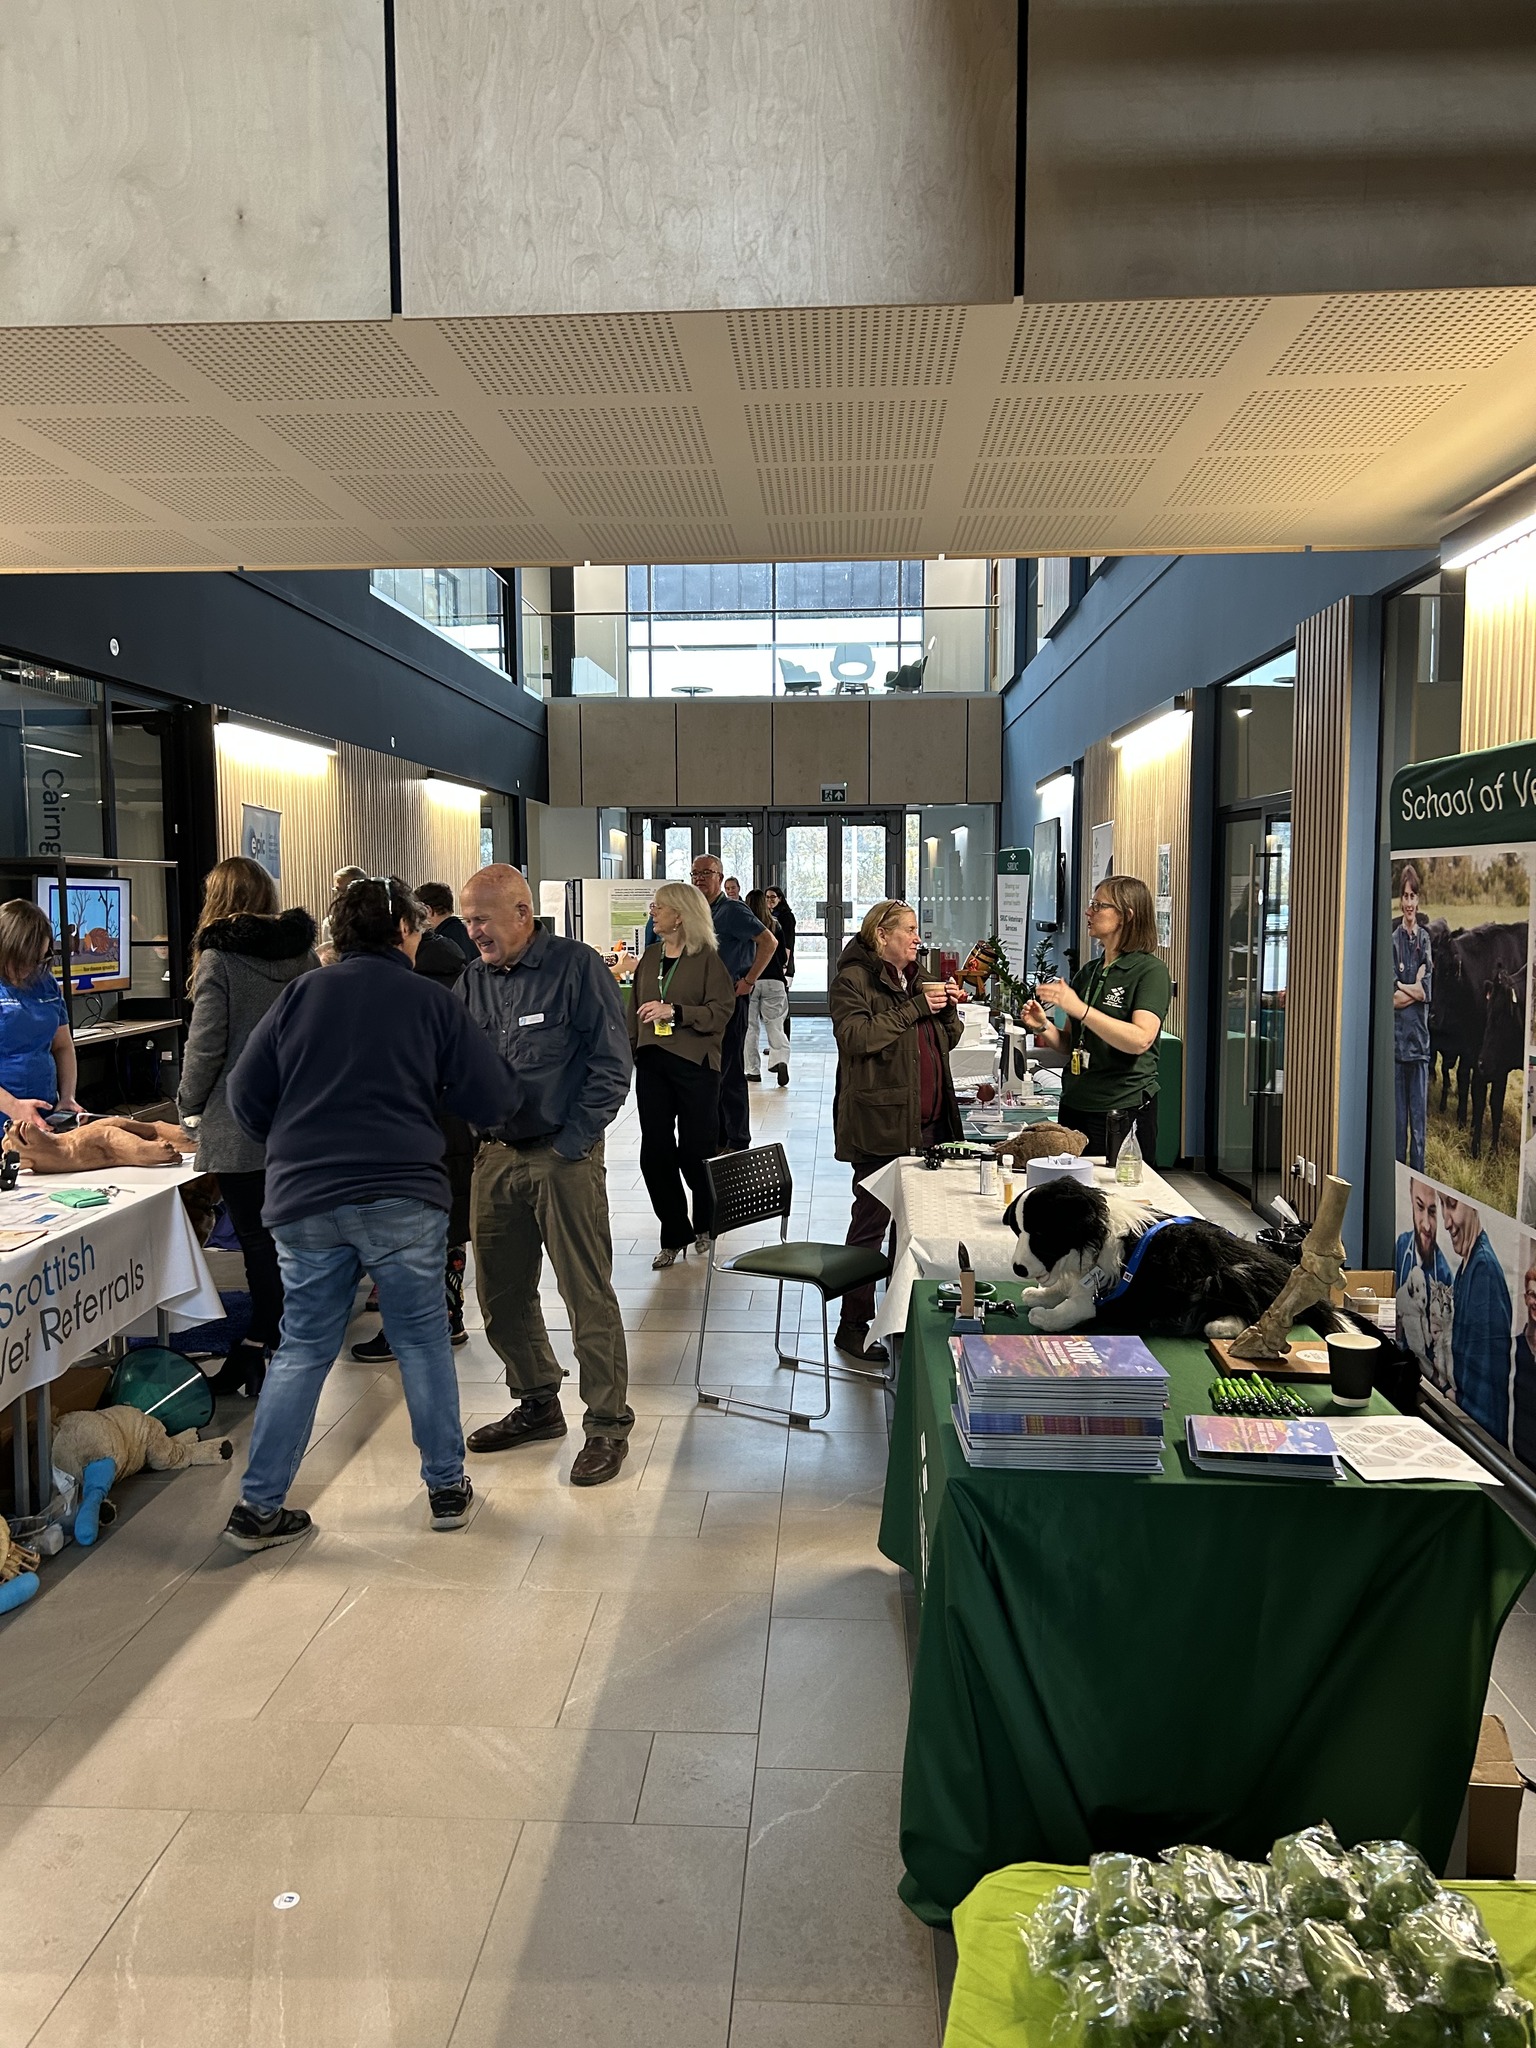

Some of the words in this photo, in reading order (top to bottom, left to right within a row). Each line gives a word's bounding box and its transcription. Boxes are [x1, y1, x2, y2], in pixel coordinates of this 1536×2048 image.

[1401, 777, 1474, 821] School
[1480, 772, 1505, 812] of
[0, 1236, 95, 1329] Scottish
[40, 1259, 144, 1351] Referrals
[1063, 1340, 1103, 1365] SRUC
